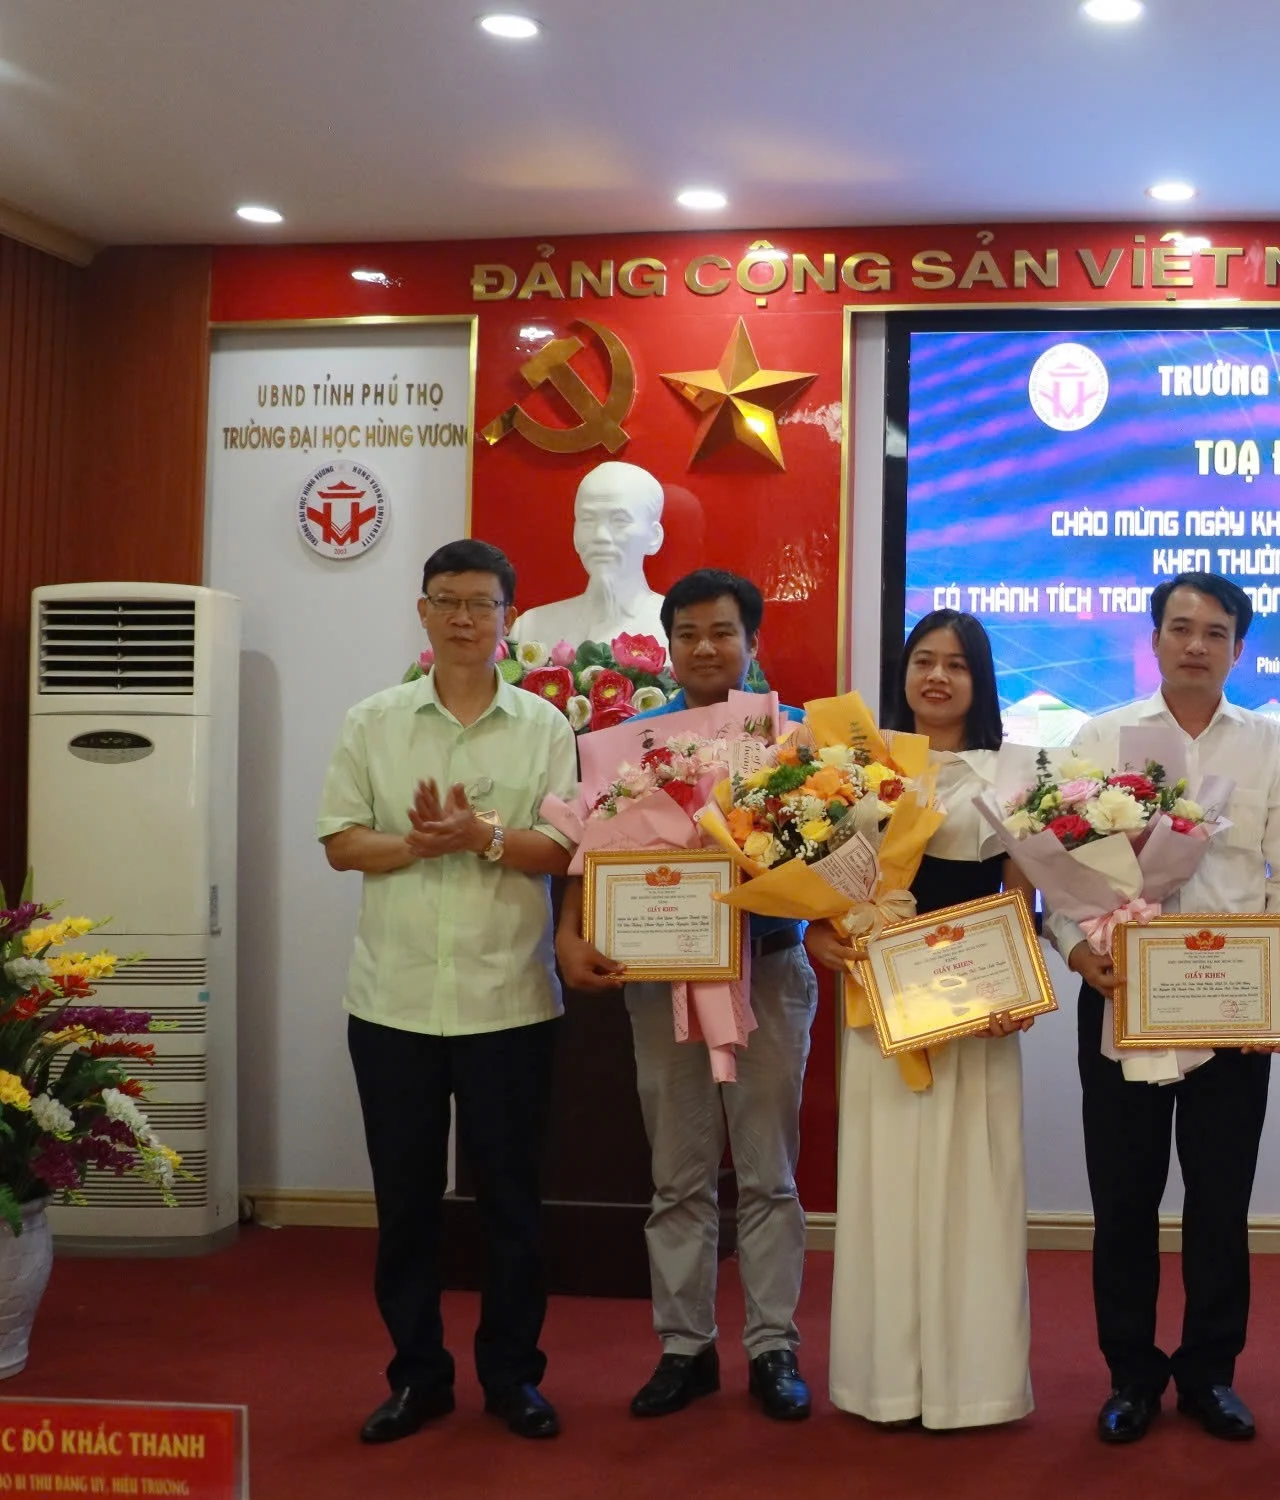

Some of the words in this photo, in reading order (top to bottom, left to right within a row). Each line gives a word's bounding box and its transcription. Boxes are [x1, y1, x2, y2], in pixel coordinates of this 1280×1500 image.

[471, 243, 668, 300] ĐẢNG
[684, 239, 892, 308] CỘNG
[911, 231, 1059, 290] SẢN
[257, 384, 306, 407] UBND
[313, 374, 354, 406] TỈNH
[361, 374, 399, 407] PHÚ
[405, 383, 444, 412] THỌ
[1158, 359, 1269, 397] TRƯỜNG
[222, 418, 286, 450] TRƯỜNG
[289, 425, 317, 454] ĐẠI
[322, 424, 361, 453] HỌC
[365, 417, 414, 448] HÙNG
[416, 423, 468, 447] VƯƠN
[1195, 439, 1260, 482] TOẠ
[1051, 506, 1108, 537] CHÀO
[1114, 505, 1179, 537] MỪNG
[1185, 505, 1245, 537] NGÀY
[1153, 548, 1211, 574] KHEN
[933, 582, 961, 613] CÓ
[967, 582, 1039, 613] THÀNH
[1046, 582, 1093, 613] TÍCH
[1100, 586, 1154, 613] TRON
[1256, 656, 1280, 674] Phú
[933, 962, 951, 975] GIẤY
[952, 959, 974, 970] KHEN
[1184, 971, 1204, 979] GIẤY
[129, 1432, 206, 1458] THANH
